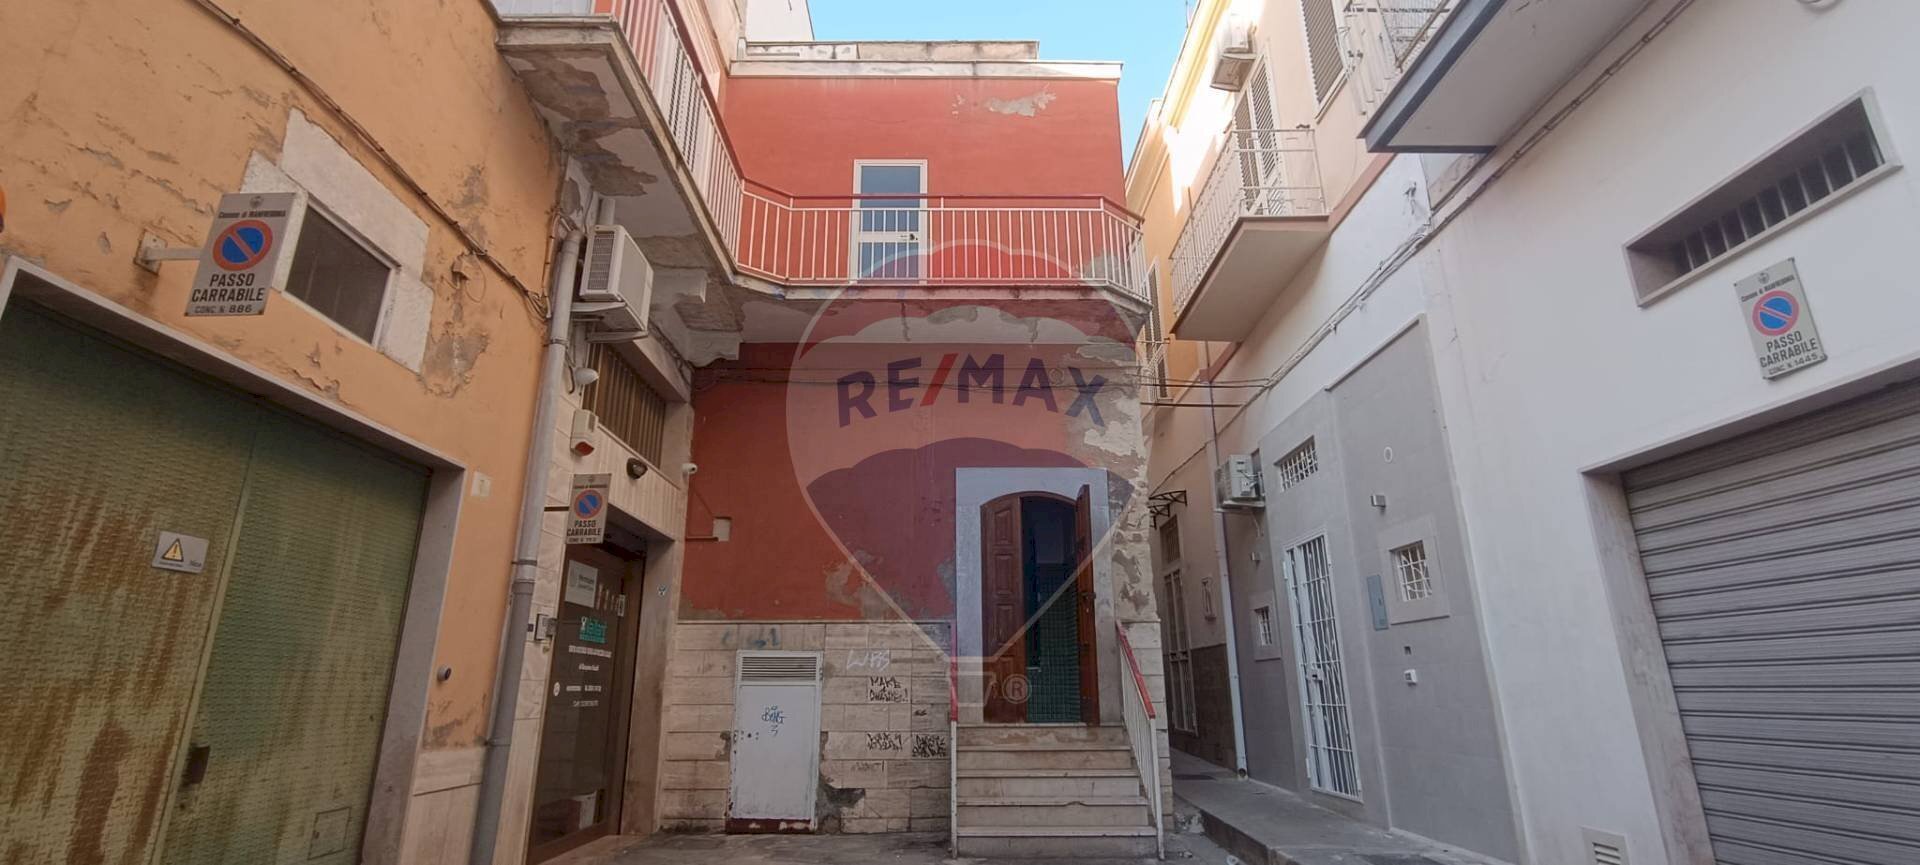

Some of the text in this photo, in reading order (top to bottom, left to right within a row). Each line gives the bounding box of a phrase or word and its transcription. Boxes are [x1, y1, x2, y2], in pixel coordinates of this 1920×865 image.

[209, 273, 255, 287] PASSO
[191, 287, 265, 302] CARRABILE
[228, 304, 253, 314] 886
[1766, 330, 1803, 353] PASSO
[1759, 338, 1818, 368] CARRABILE
[574, 519, 597, 528] PASSO
[566, 527, 602, 537] CARRABILE
